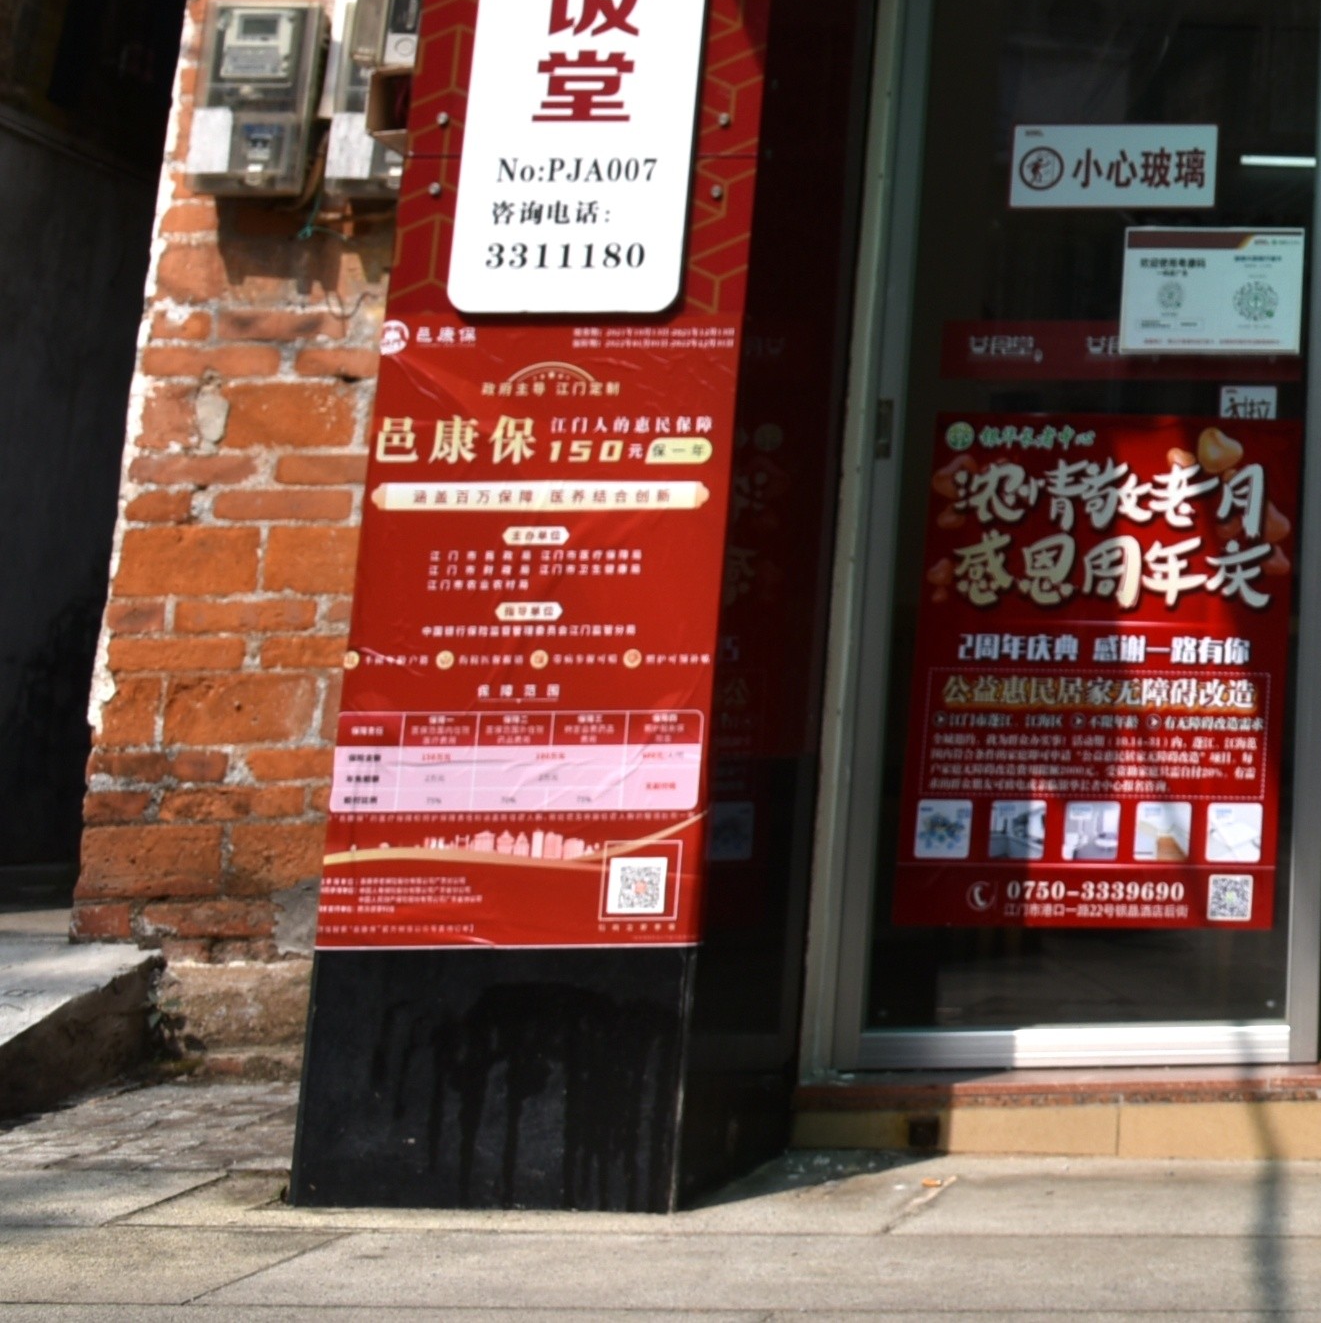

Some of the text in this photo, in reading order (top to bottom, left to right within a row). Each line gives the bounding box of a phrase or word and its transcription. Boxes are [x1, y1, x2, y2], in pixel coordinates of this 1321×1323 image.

[1073, 147, 1207, 189] 小心玻璃
[485, 242, 646, 271] 3311180
[416, 326, 477, 344] 邑康保
[480, 381, 621, 397] 政府主导 江门定制
[550, 415, 714, 435] 江门人的惠民保障
[375, 414, 536, 465] 邑康保
[978, 424, 1096, 451] 银华长者中心
[651, 442, 706, 458] 保一年
[412, 488, 671, 505] 涵盖百万保障 医养结合创新
[954, 458, 1266, 540] 浓情敬老月
[511, 529, 563, 543] 主办单位
[953, 531, 1273, 609] 感恩周年庆
[503, 604, 555, 618] 指导单位
[958, 633, 1252, 665] 2周年庆典 感谢一路有你
[942, 675, 1257, 709] 公益惠民居家无障碍改造
[1006, 880, 1186, 901] 0750-3339690
